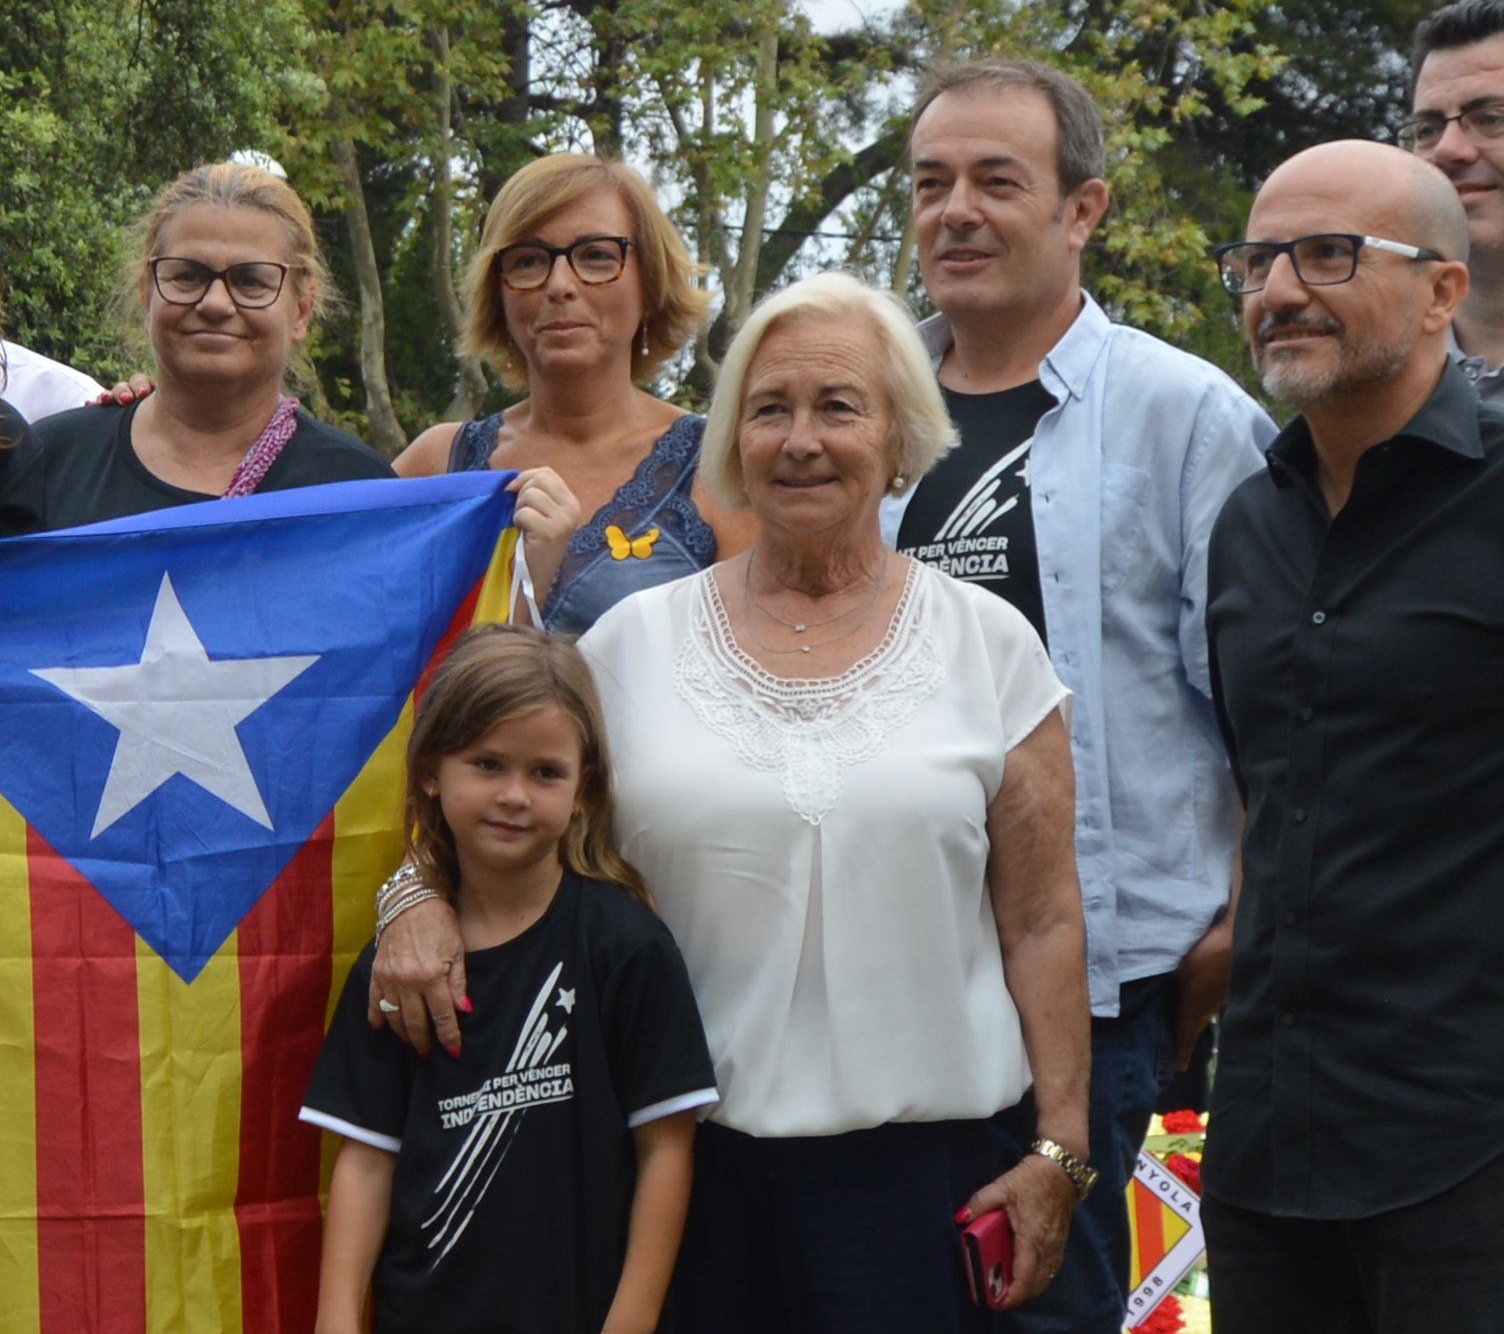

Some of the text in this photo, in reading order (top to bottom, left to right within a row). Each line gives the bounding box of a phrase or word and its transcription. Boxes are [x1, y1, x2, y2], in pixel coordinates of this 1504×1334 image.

[917, 543, 945, 559] PER
[947, 536, 1009, 555] VÈNCER
[493, 1074, 519, 1090] PER
[519, 1063, 571, 1083] VÈNCER
[441, 1078, 575, 1129] INDENDÈNCIA
[1127, 1276, 1164, 1317] 1998
